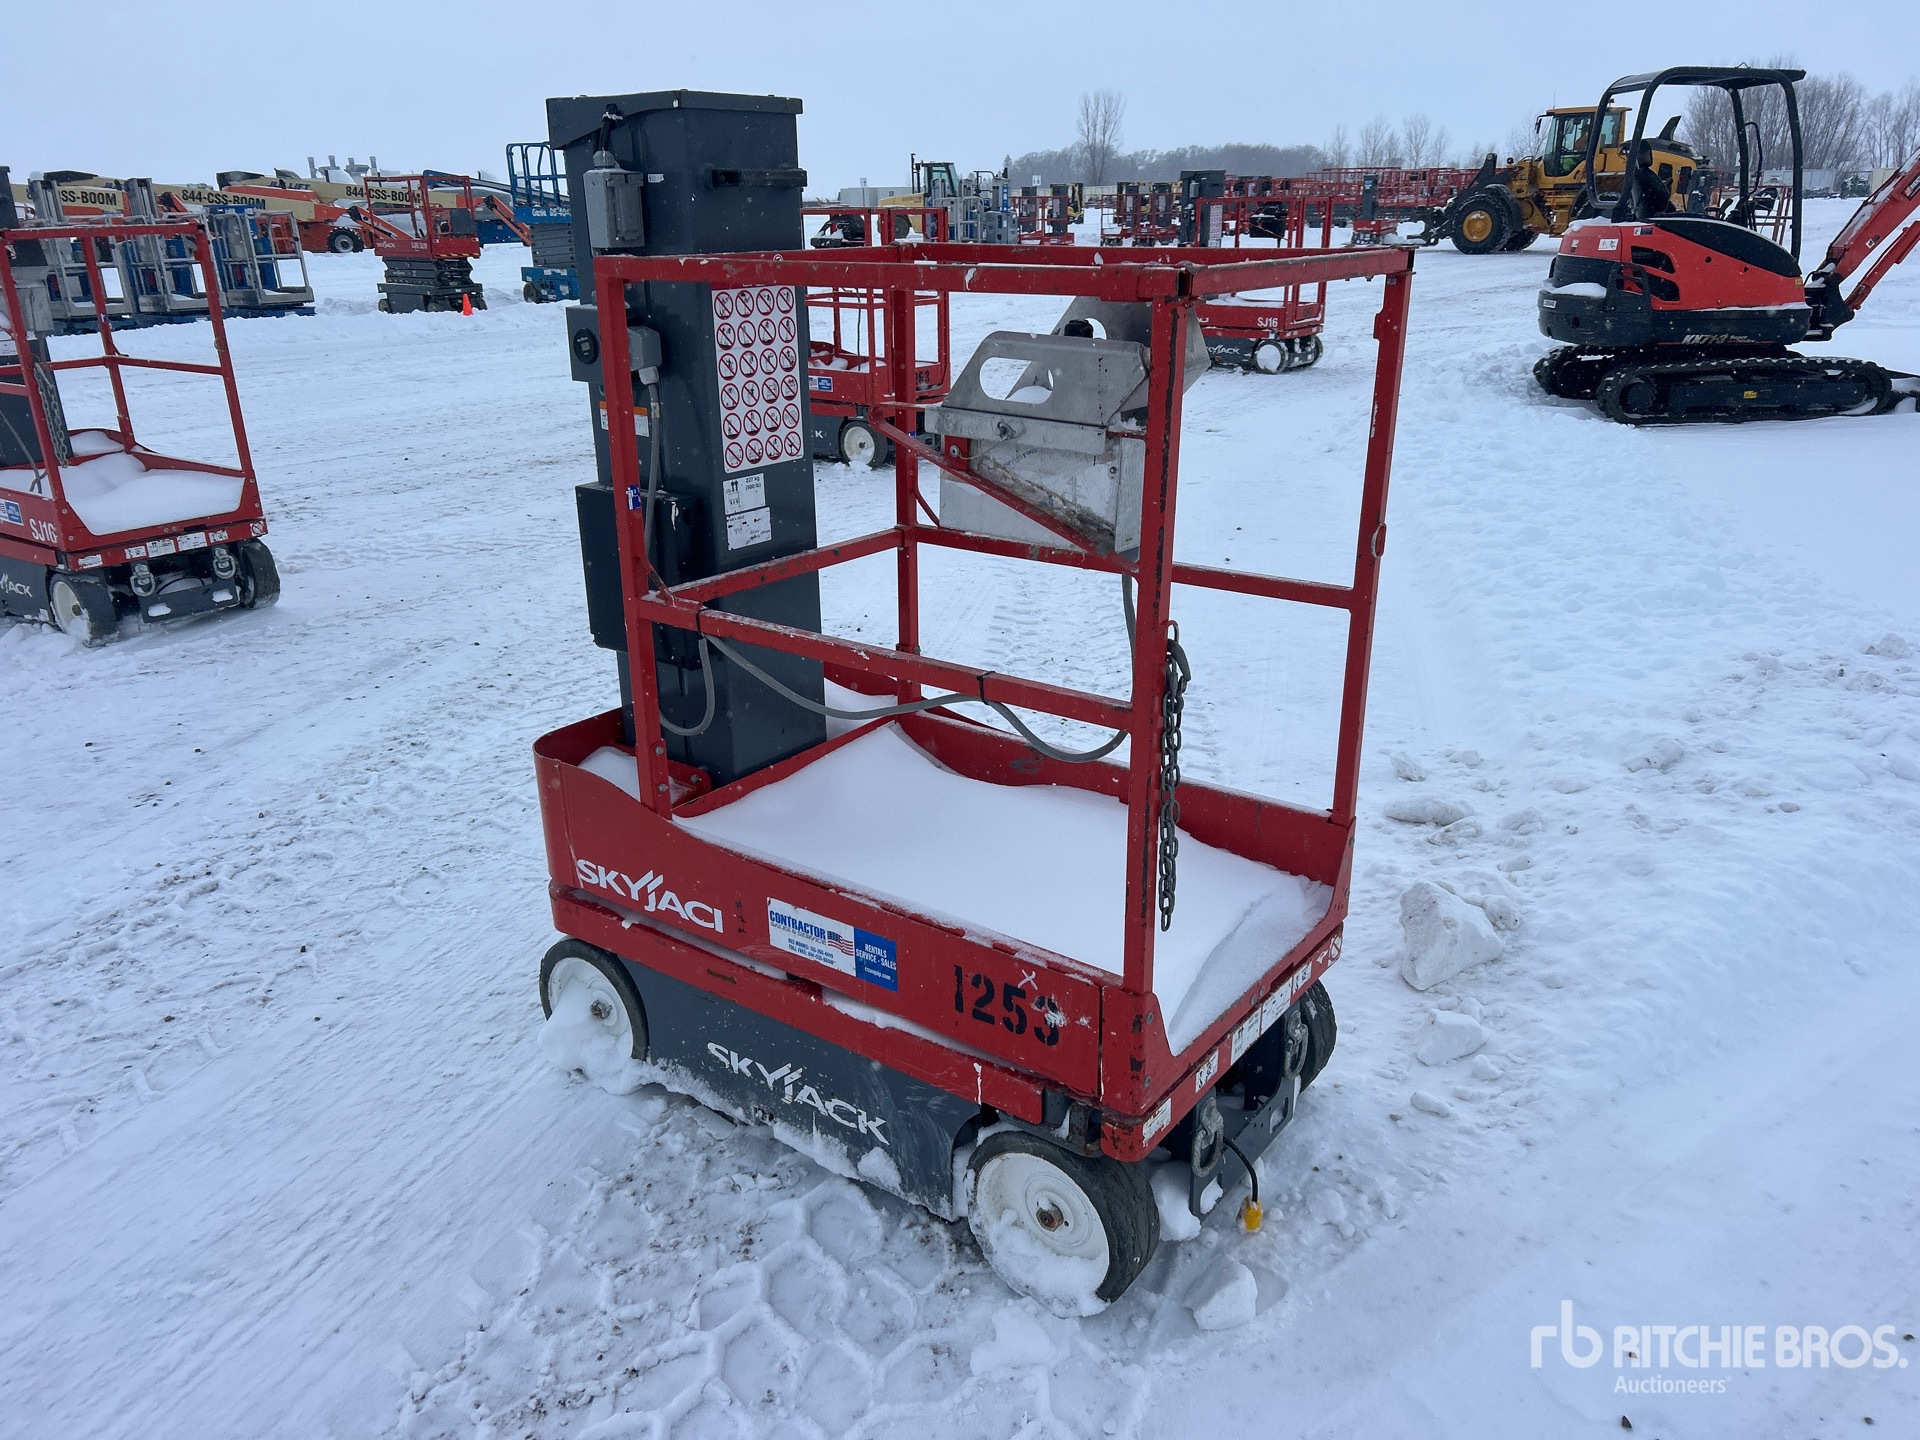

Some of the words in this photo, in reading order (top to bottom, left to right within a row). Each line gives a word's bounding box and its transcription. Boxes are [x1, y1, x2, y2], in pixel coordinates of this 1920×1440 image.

[1257, 317, 1278, 328] SJ16
[769, 910, 826, 940] CONTRACTOR
[856, 949, 877, 963] SERVICE
[880, 958, 897, 970] SALES
[864, 943, 887, 958] RENTALS
[707, 1042, 890, 1146] SKYJACK
